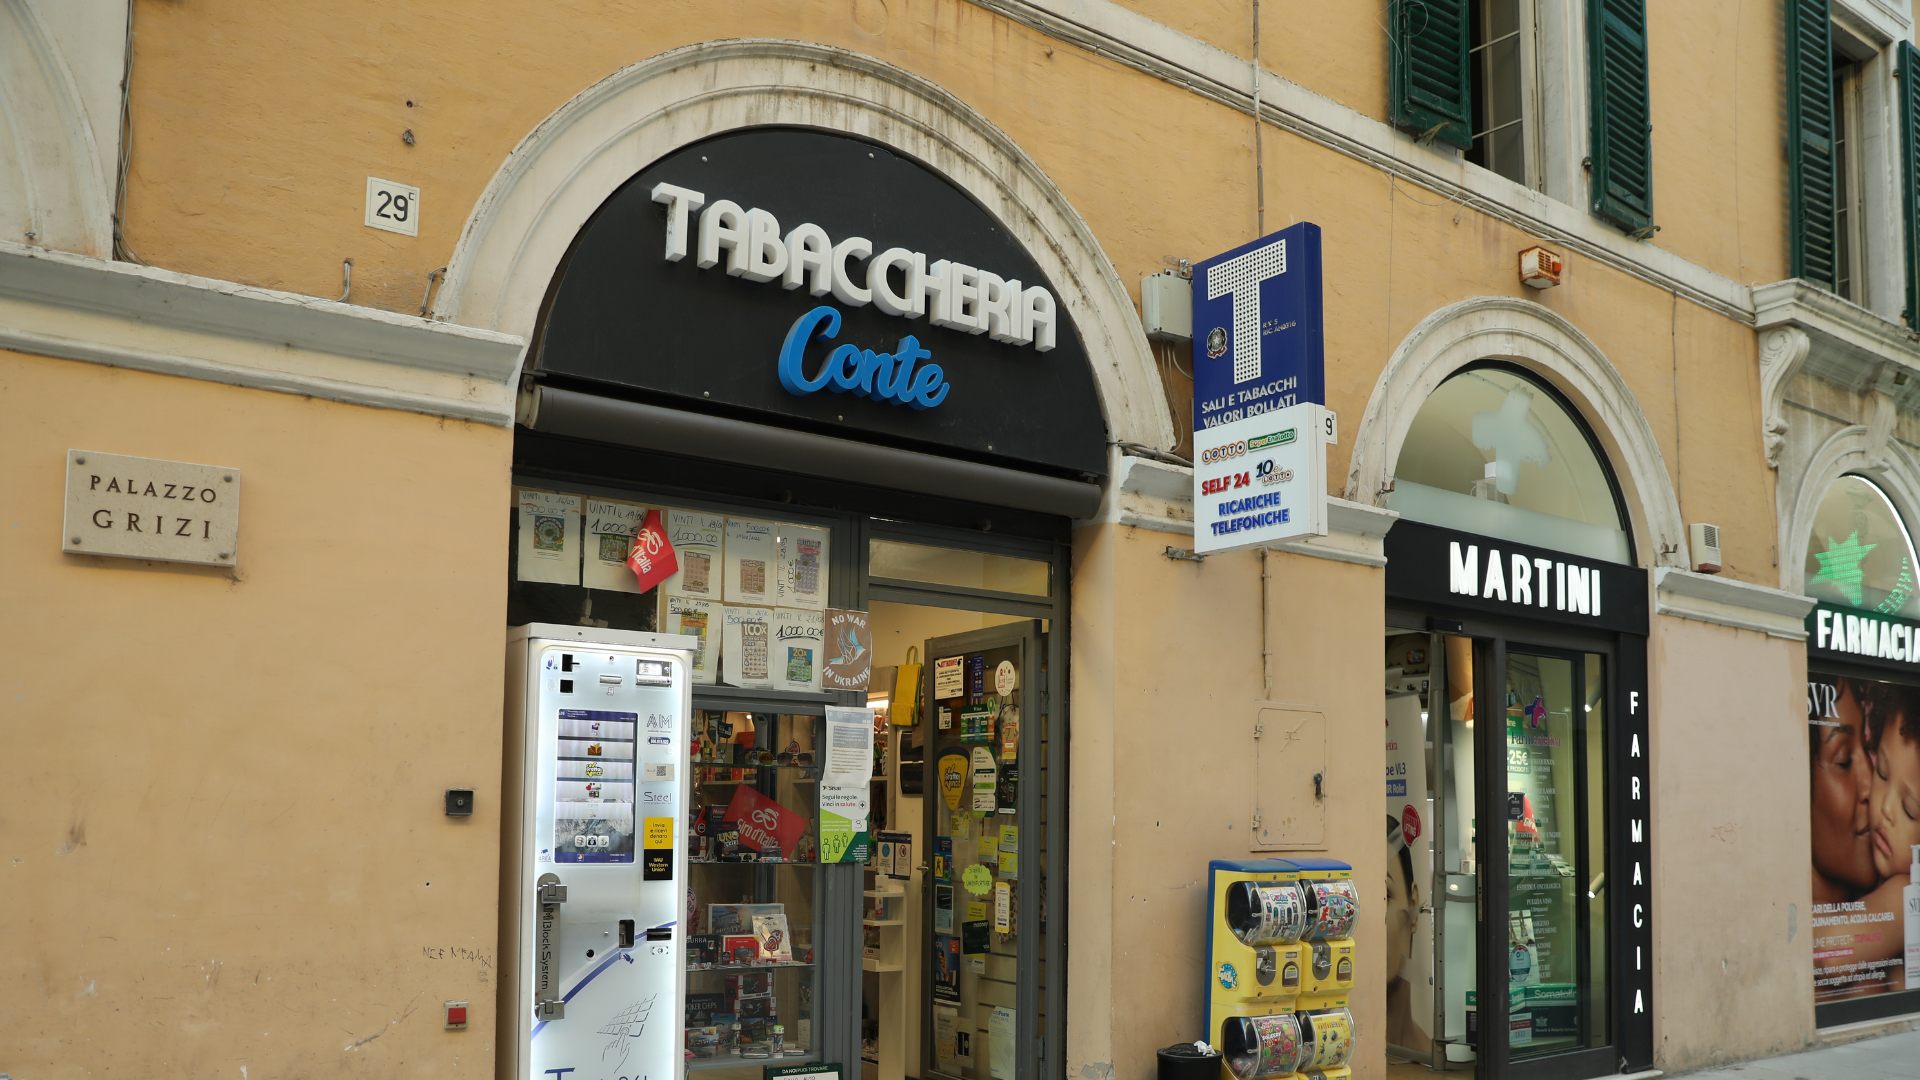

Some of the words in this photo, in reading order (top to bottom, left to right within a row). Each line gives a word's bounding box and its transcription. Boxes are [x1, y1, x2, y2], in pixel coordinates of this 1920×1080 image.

[651, 181, 1057, 353] TABACCHERIA
[1207, 238, 1286, 385] T
[778, 306, 951, 411] Conte
[1202, 397, 1226, 415] SALI
[1228, 393, 1236, 407] E
[1237, 375, 1298, 403] TABACCHI
[1203, 410, 1243, 430] VALORI
[1246, 393, 1297, 420] BOLLATI
[1202, 441, 1247, 464] LOTTO
[1256, 460, 1274, 478] 10
[1262, 470, 1293, 485] LOTTO
[89, 475, 217, 504] PALAZZO
[522, 492, 540, 500] VINTI
[1201, 476, 1231, 496] SELF
[1233, 471, 1251, 488] 24
[589, 501, 617, 517] VINTI
[1218, 491, 1281, 516] RICARICHE
[93, 509, 211, 540] GRIZI
[672, 513, 694, 525] VINTI
[1211, 508, 1290, 536] TELEFONICHE
[1450, 541, 1600, 616] MARTINI
[831, 614, 845, 626] NO
[846, 614, 867, 629] WAR
[1817, 608, 1920, 663] FARMACIA
[822, 666, 835, 679] IN
[834, 666, 870, 687] UKRAINE
[643, 791, 672, 803] Steel
[717, 831, 739, 841] UNO
[737, 818, 752, 838] Giro
[1629, 691, 1643, 1013] FARMACIA
[1823, 902, 1841, 913] DELLA
[1850, 912, 1868, 924] ACQUA
[1868, 911, 1895, 922] CALCAREA
[542, 922, 551, 949] Block
